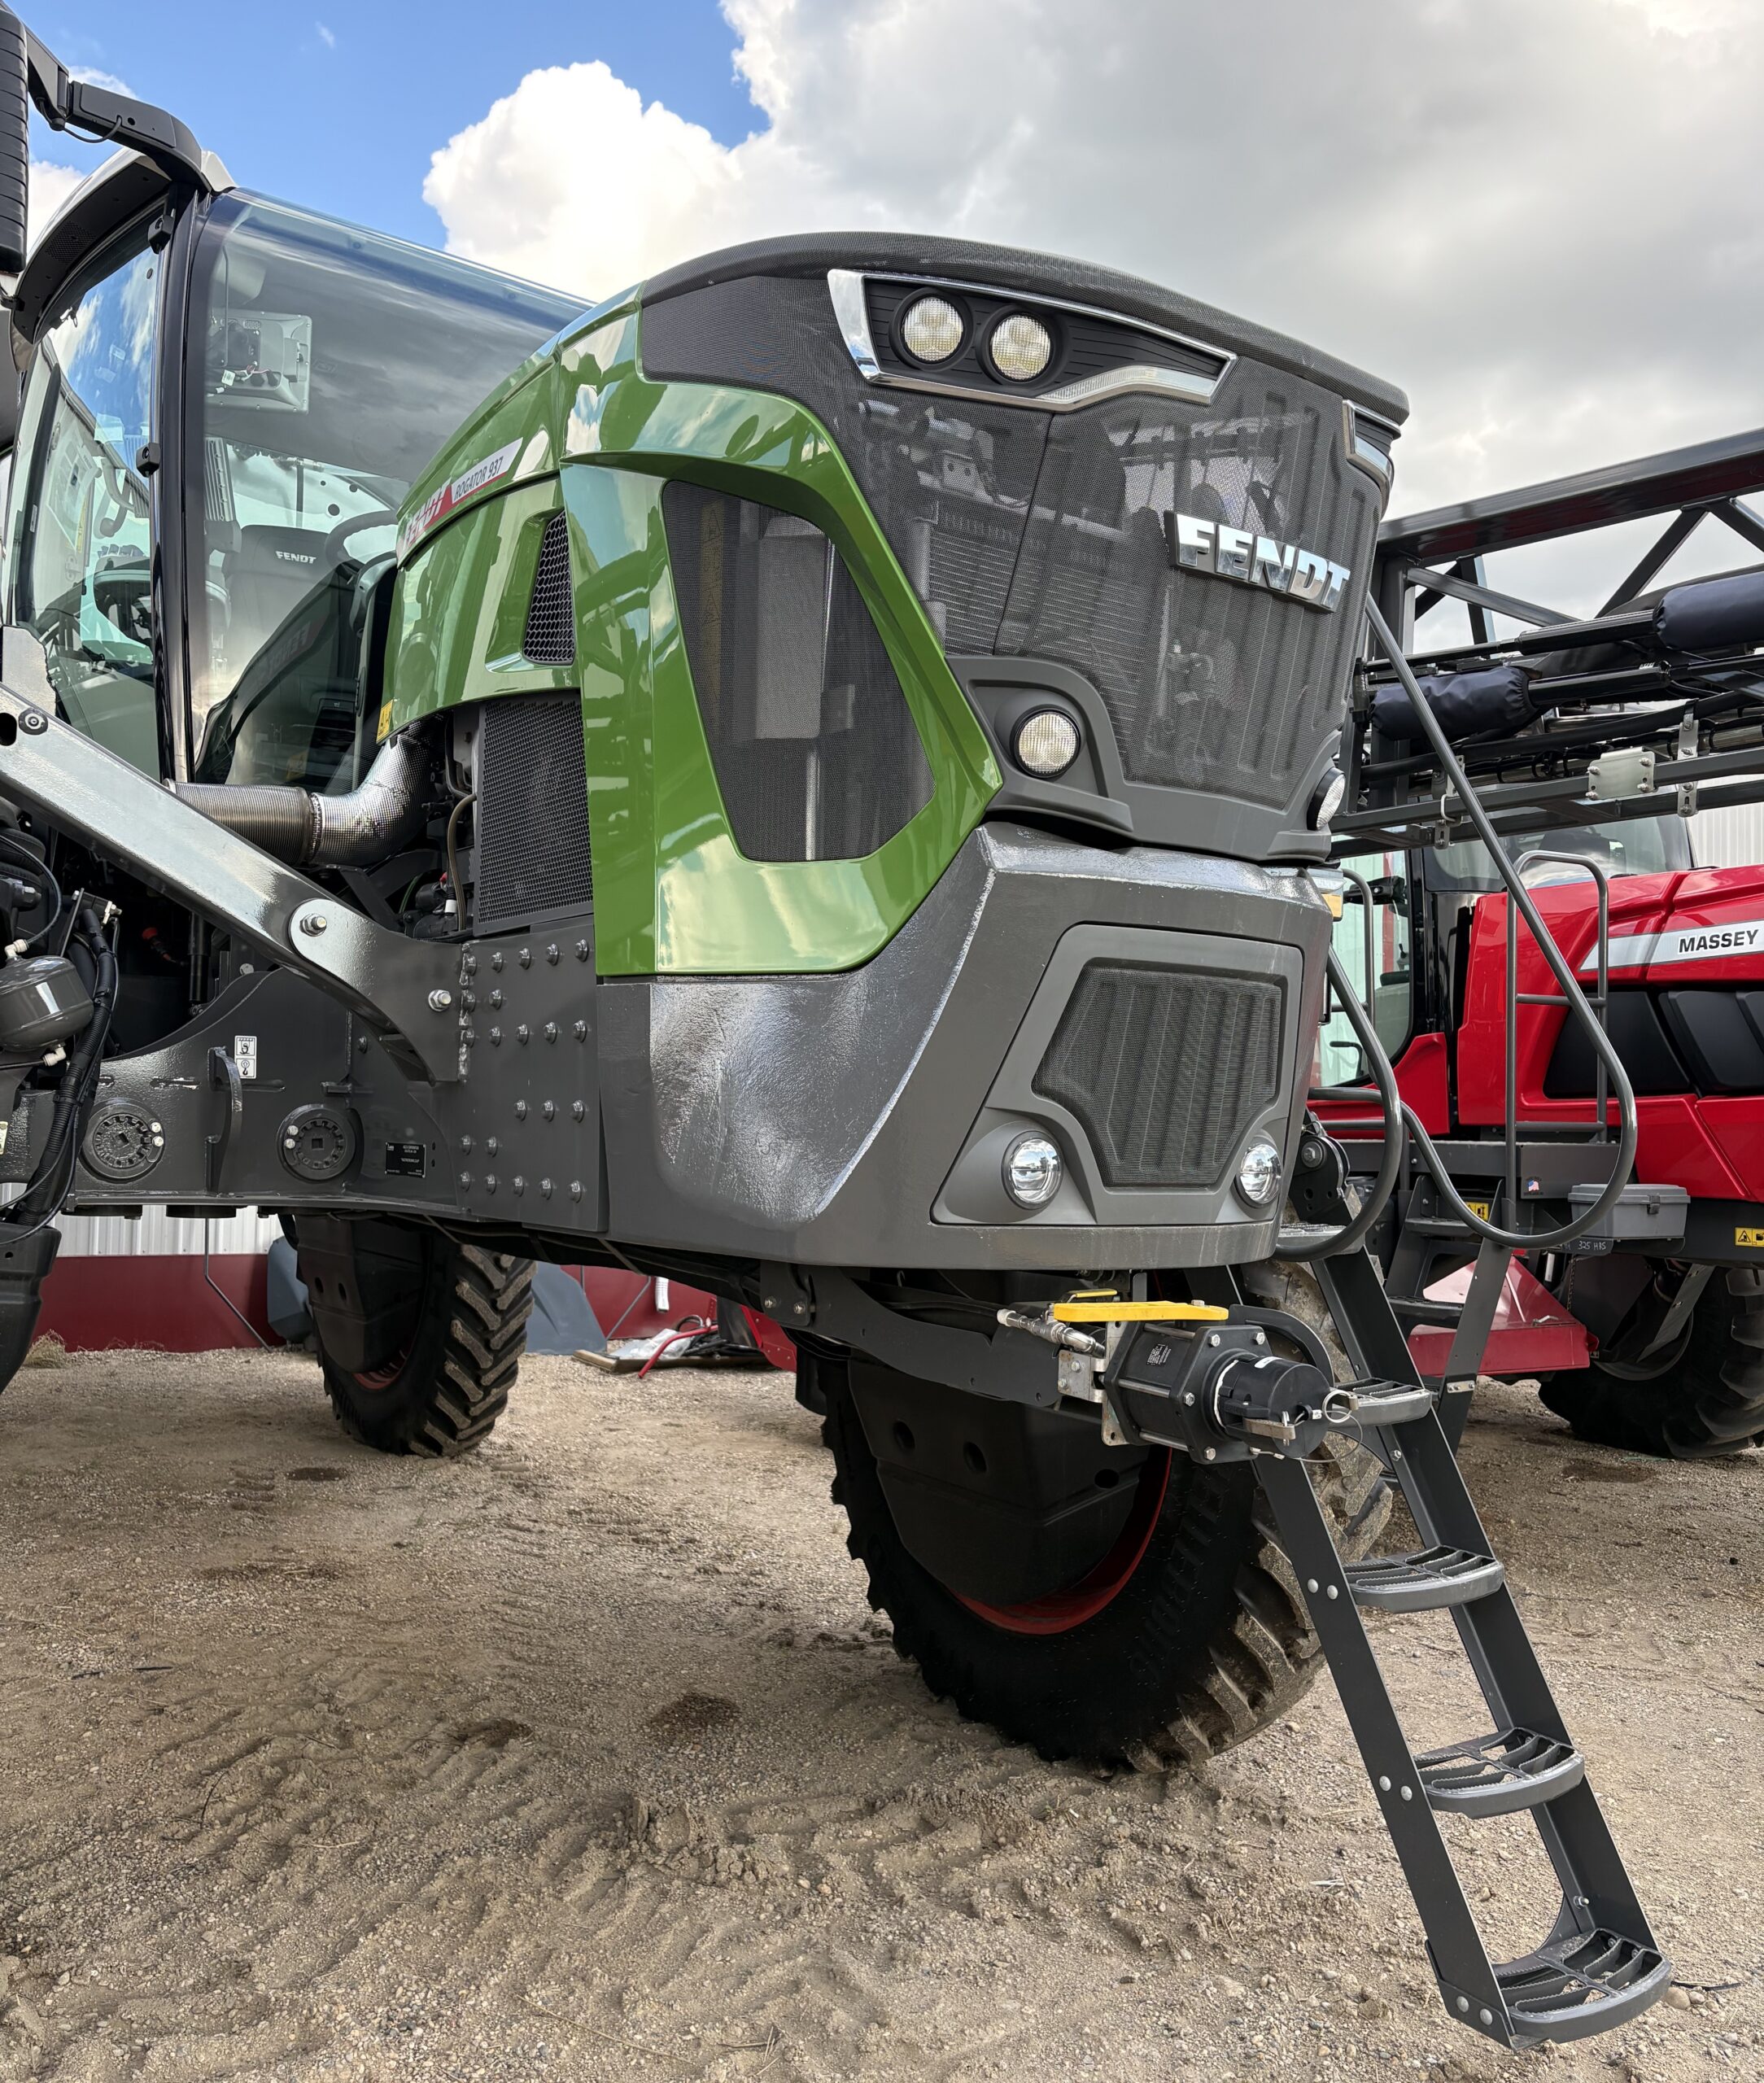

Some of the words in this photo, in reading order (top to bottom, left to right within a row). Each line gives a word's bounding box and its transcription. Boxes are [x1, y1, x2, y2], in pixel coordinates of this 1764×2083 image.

[403, 477, 452, 551] FENDT
[454, 465, 487, 501] ROGATOR
[488, 456, 504, 479] 937
[275, 550, 317, 564] FENDT
[1174, 513, 1351, 609] FENDT
[1679, 928, 1759, 953] MASSEY
[1578, 1240, 1591, 1250] 325
[1593, 1241, 1607, 1251] HRS
